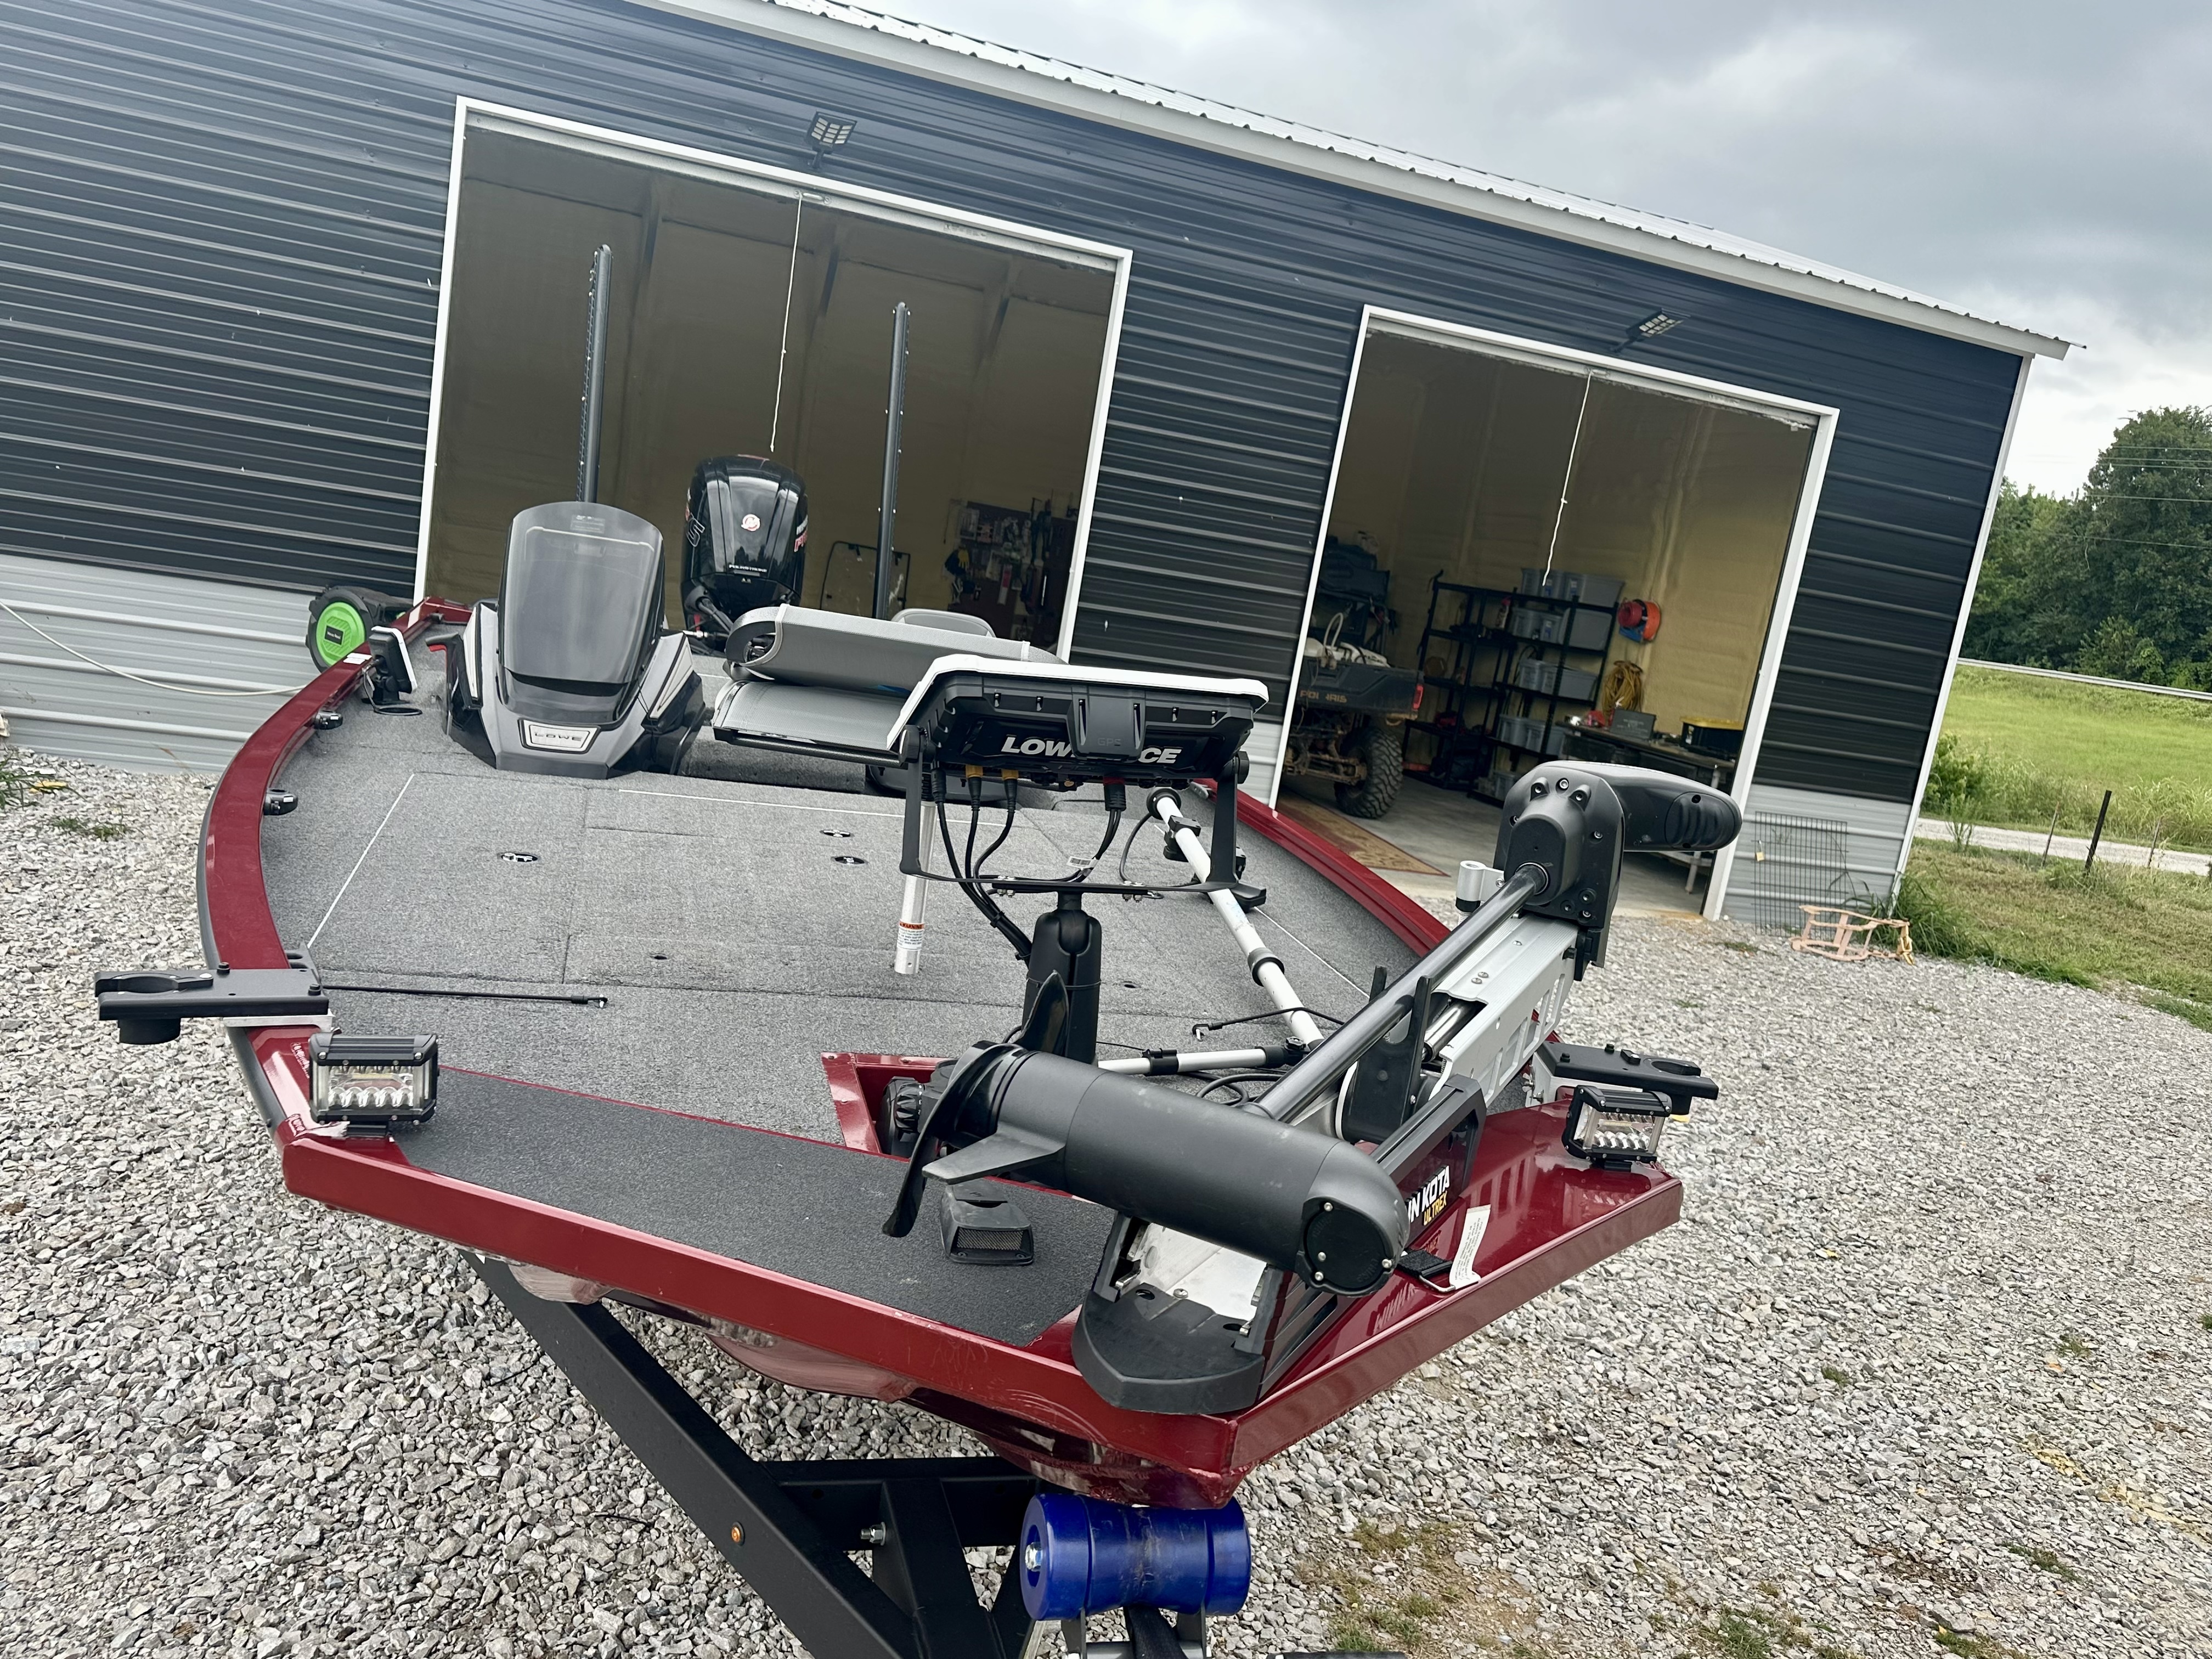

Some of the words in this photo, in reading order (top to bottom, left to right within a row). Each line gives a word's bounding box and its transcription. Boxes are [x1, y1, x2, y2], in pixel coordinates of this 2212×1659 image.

[534, 733, 582, 742] LOWE
[1001, 736, 1182, 764] LOWCE
[1097, 737, 1121, 747] GPS
[1422, 1165, 1450, 1212] KOTA
[1423, 1190, 1448, 1226] ULTREX
